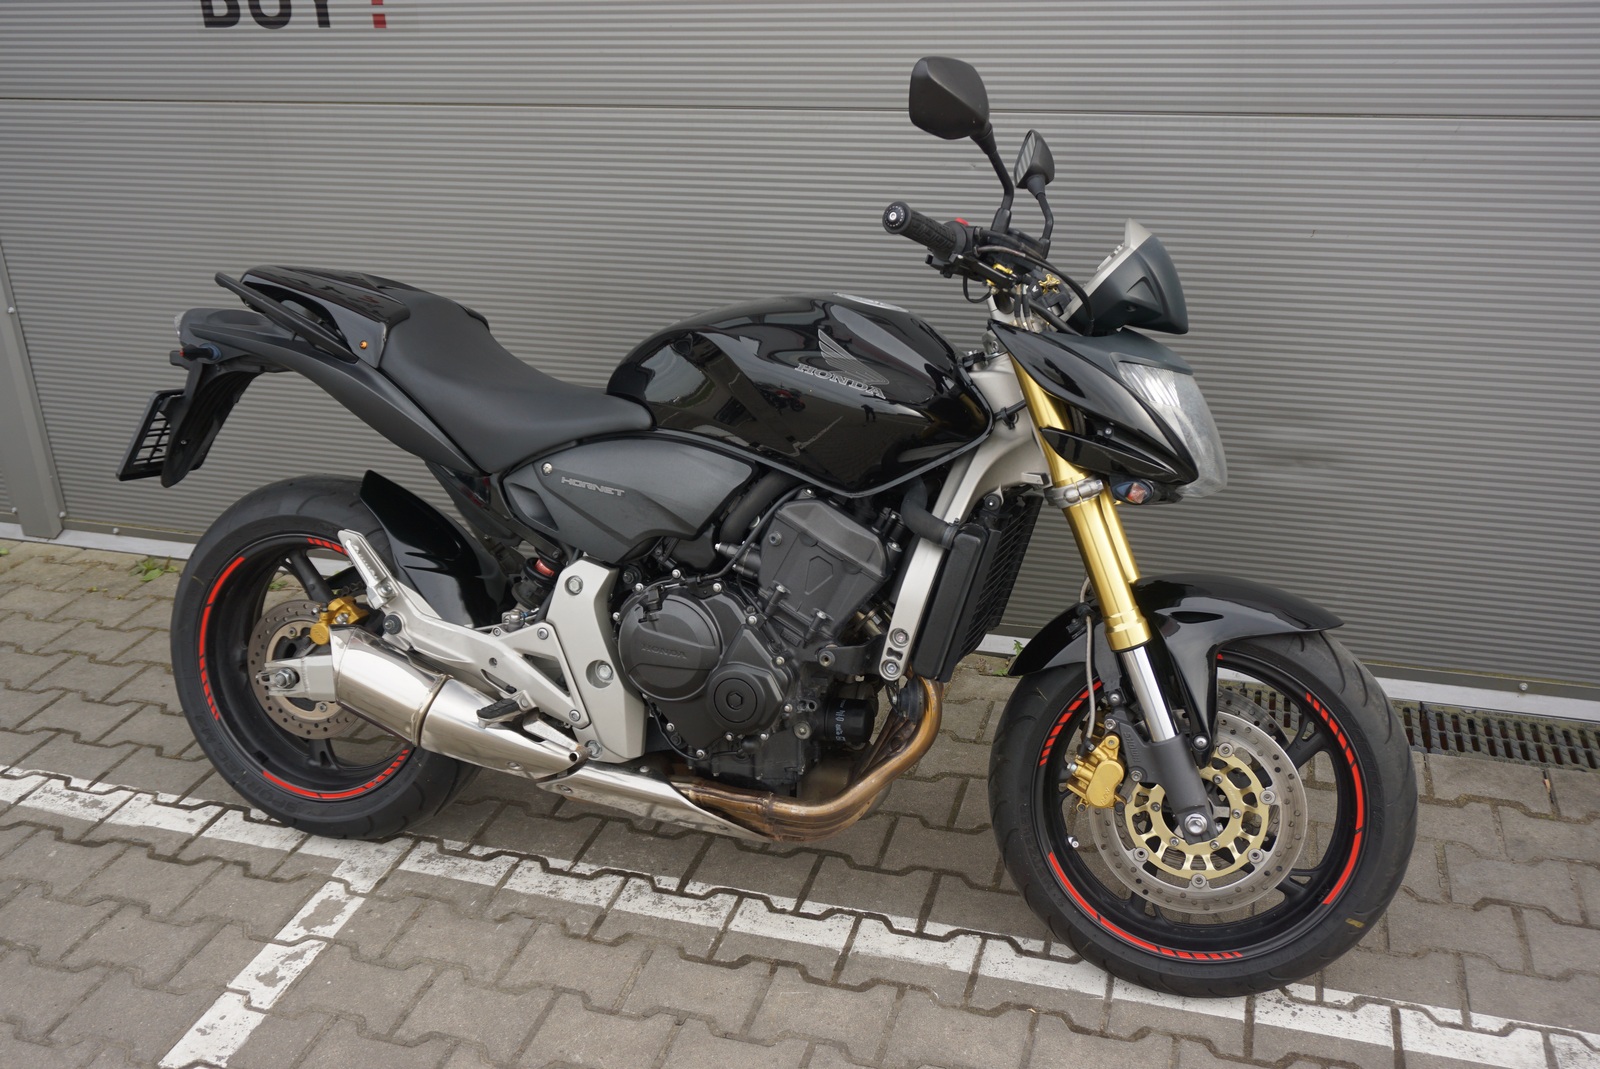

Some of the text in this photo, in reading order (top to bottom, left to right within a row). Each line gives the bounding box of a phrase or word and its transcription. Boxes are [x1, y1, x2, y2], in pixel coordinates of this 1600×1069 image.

[794, 362, 886, 400] HONDA
[561, 476, 625, 497] HORNET
[640, 642, 688, 660] HONDA
